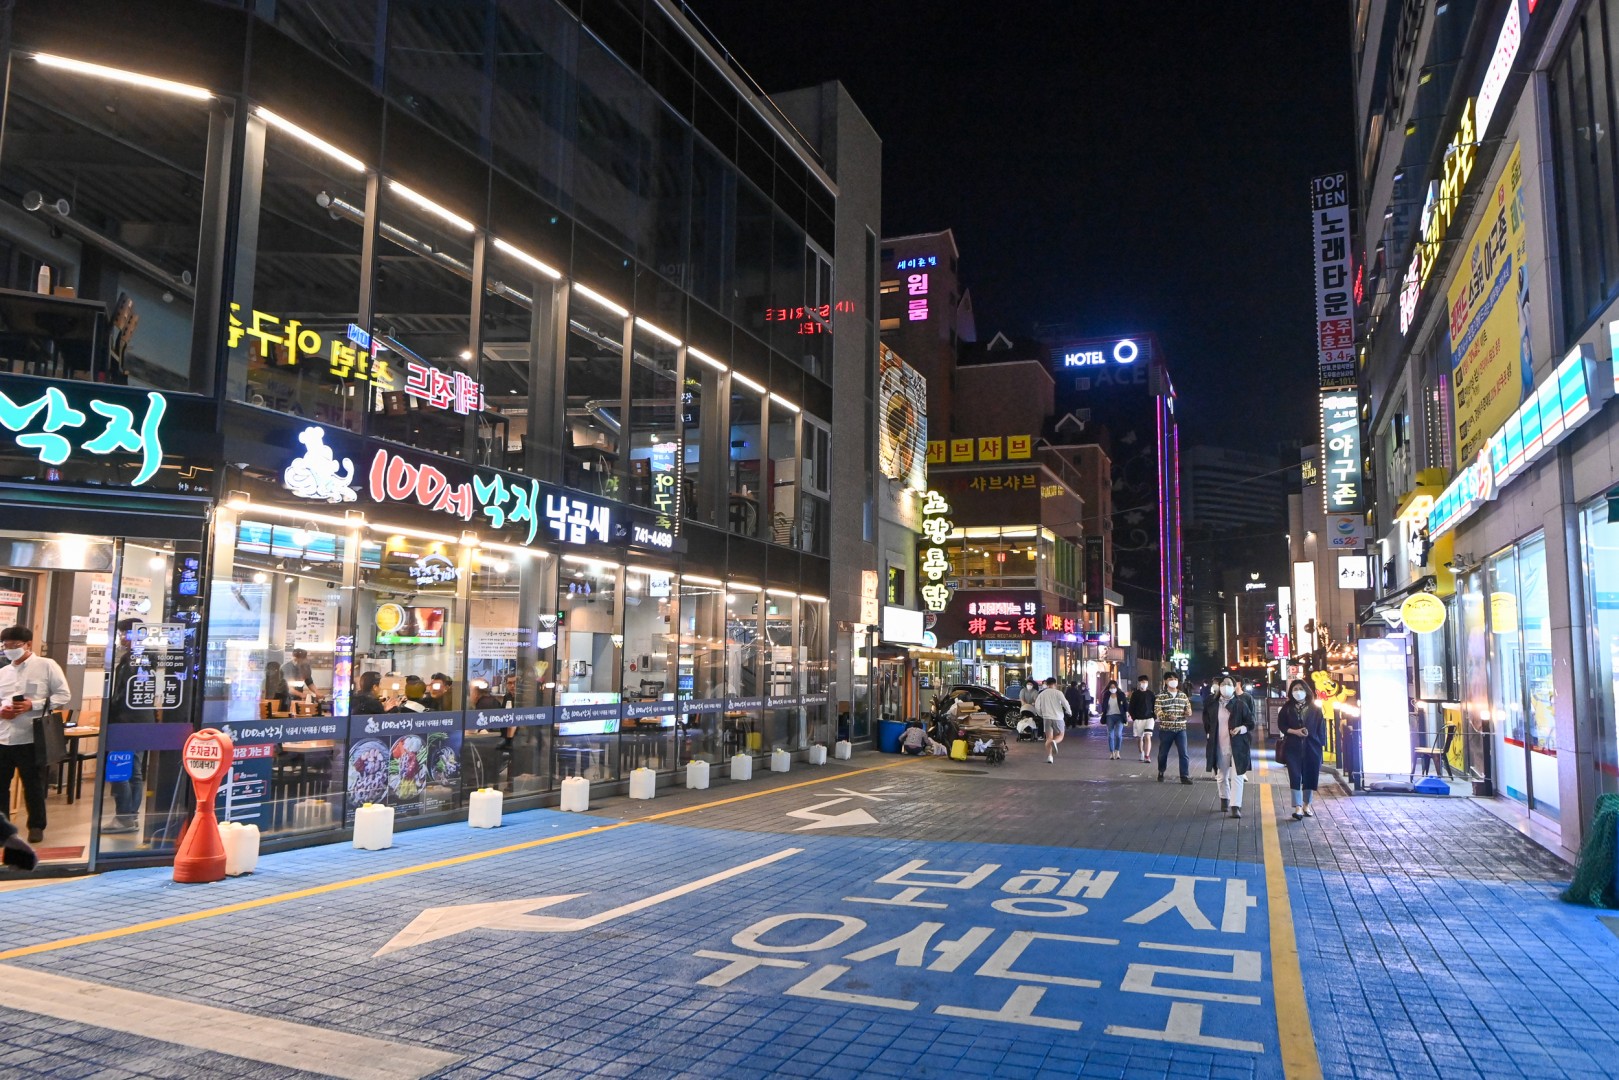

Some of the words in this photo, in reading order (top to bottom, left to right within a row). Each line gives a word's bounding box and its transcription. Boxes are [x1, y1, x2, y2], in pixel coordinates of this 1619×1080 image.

[1314, 174, 1345, 192] TOP
[1316, 190, 1346, 208] TEN
[1484, 206, 1508, 281] 야구존
[1320, 212, 1349, 317] 노래타운
[907, 273, 929, 321] 원룸
[1322, 320, 1352, 336] 소주
[1064, 350, 1106, 367] HOTEL
[1113, 339, 1139, 364] O
[1322, 335, 1353, 351] 호프
[0, 387, 167, 486] 낙지
[927, 440, 1028, 461] 샤브샤브
[1328, 434, 1358, 506] 야구존
[969, 474, 1037, 493] 샤브샤브
[369, 448, 540, 546] 100세낙지
[546, 494, 610, 545] 낙곱새
[634, 526, 673, 549] 741-4499
[922, 490, 950, 613] 노랑통닭
[132, 680, 155, 692] 모든
[132, 692, 154, 704] 포장
[241, 725, 283, 739] 100세낙지
[189, 745, 219, 758] 주차금지
[842, 860, 1258, 934] 보행자
[693, 913, 1265, 1054] 우선도로
